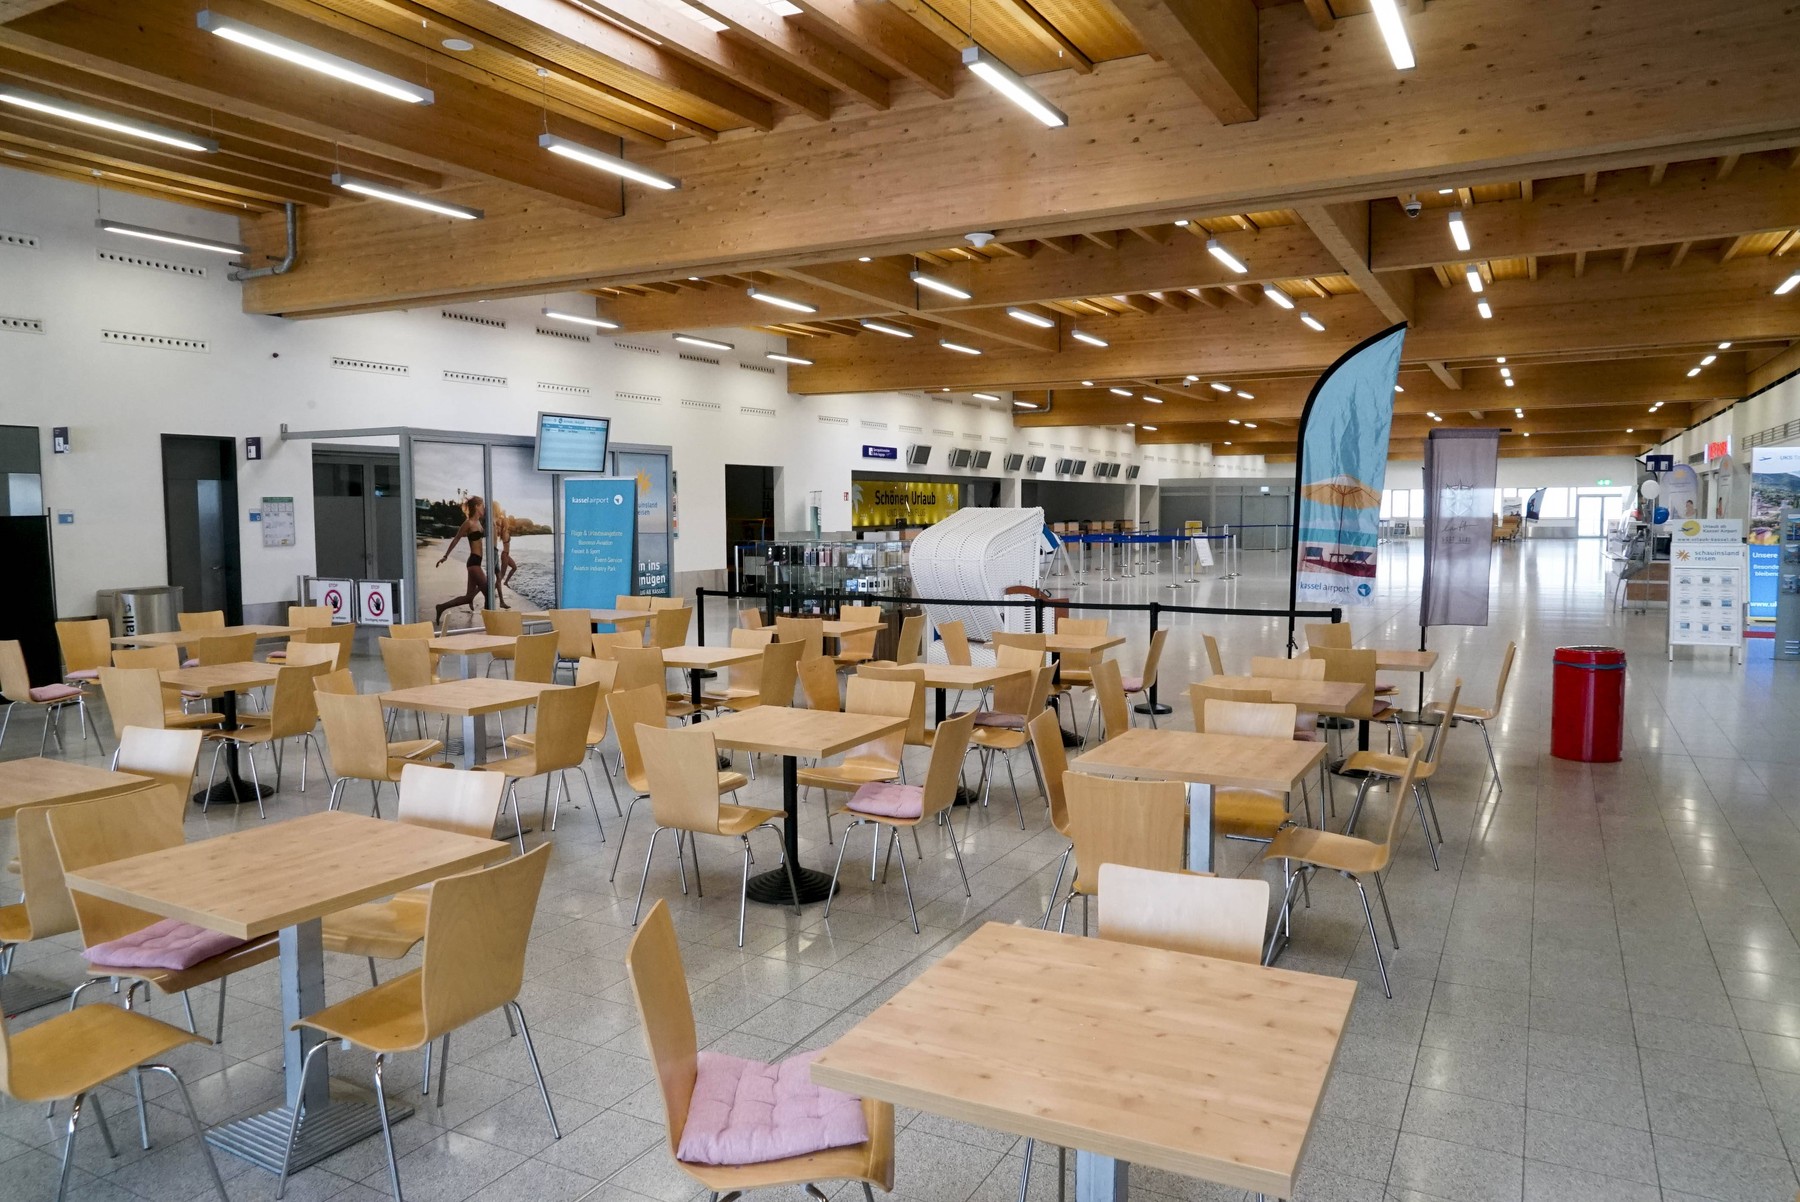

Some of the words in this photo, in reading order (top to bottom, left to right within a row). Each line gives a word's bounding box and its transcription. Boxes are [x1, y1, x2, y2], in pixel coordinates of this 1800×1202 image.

[875, 490, 908, 505] Schönen
[911, 491, 936, 505] Urlaub
[648, 560, 661, 571] ins
